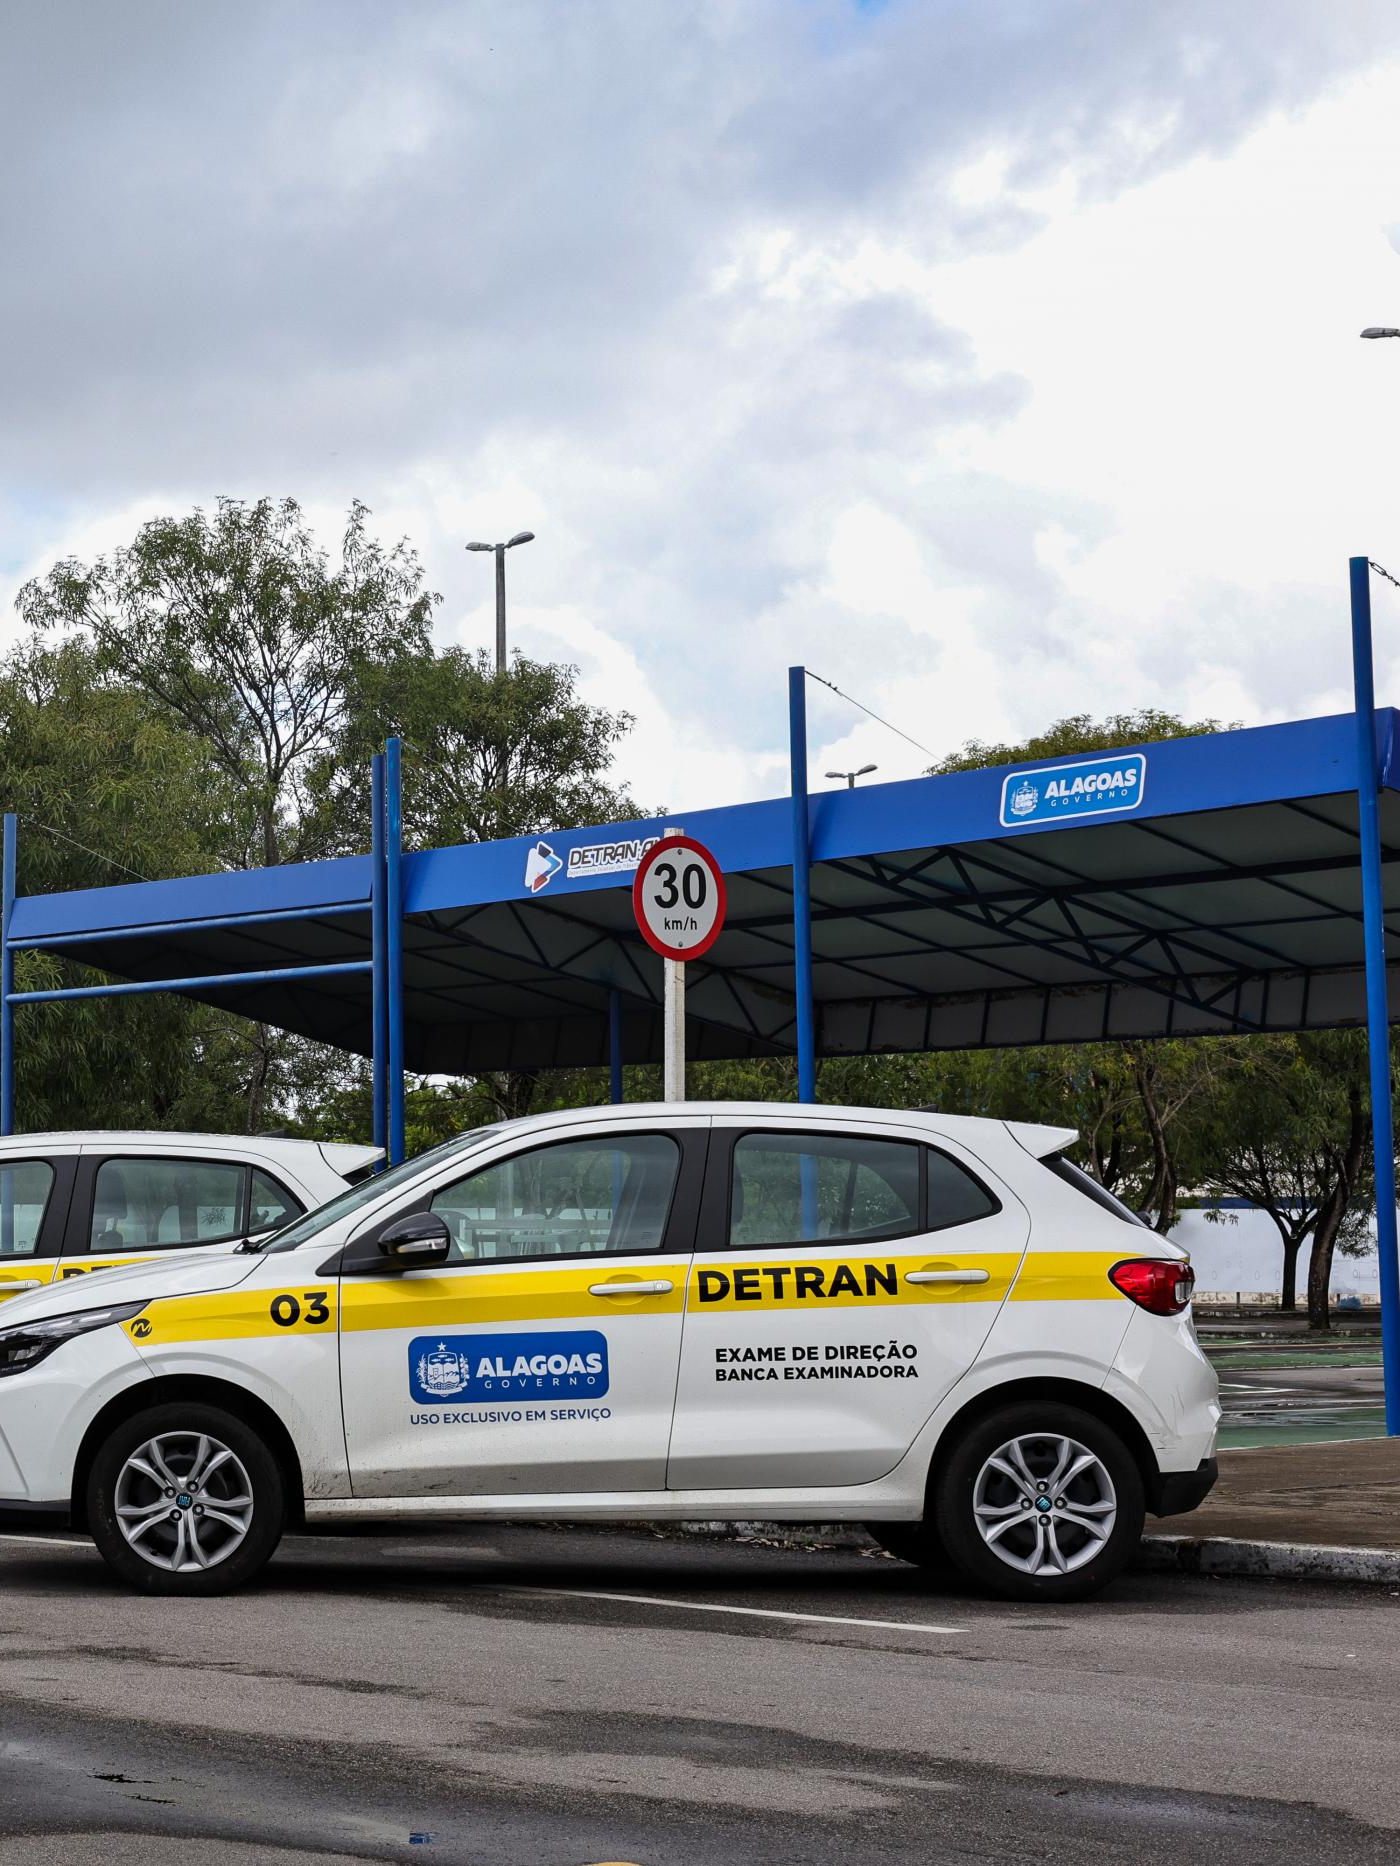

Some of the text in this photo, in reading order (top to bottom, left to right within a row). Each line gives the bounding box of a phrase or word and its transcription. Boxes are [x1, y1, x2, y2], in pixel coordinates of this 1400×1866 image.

[1044, 768, 1137, 799] ALAGOAS
[1050, 789, 1128, 807] GOVERNO
[654, 863, 707, 909] 30
[664, 916, 697, 931] km/h
[697, 1263, 898, 1303] DETRAN
[270, 1292, 329, 1326] 03
[715, 1340, 918, 1362] EXAME DE DIREÇÃO
[476, 1353, 603, 1378] ALAGOAS
[715, 1365, 919, 1381] BANCA EXAMINADORA
[485, 1376, 596, 1389] GOVERNO
[410, 1407, 612, 1425] USO EXCLUSIVO EM SERVIÇO
